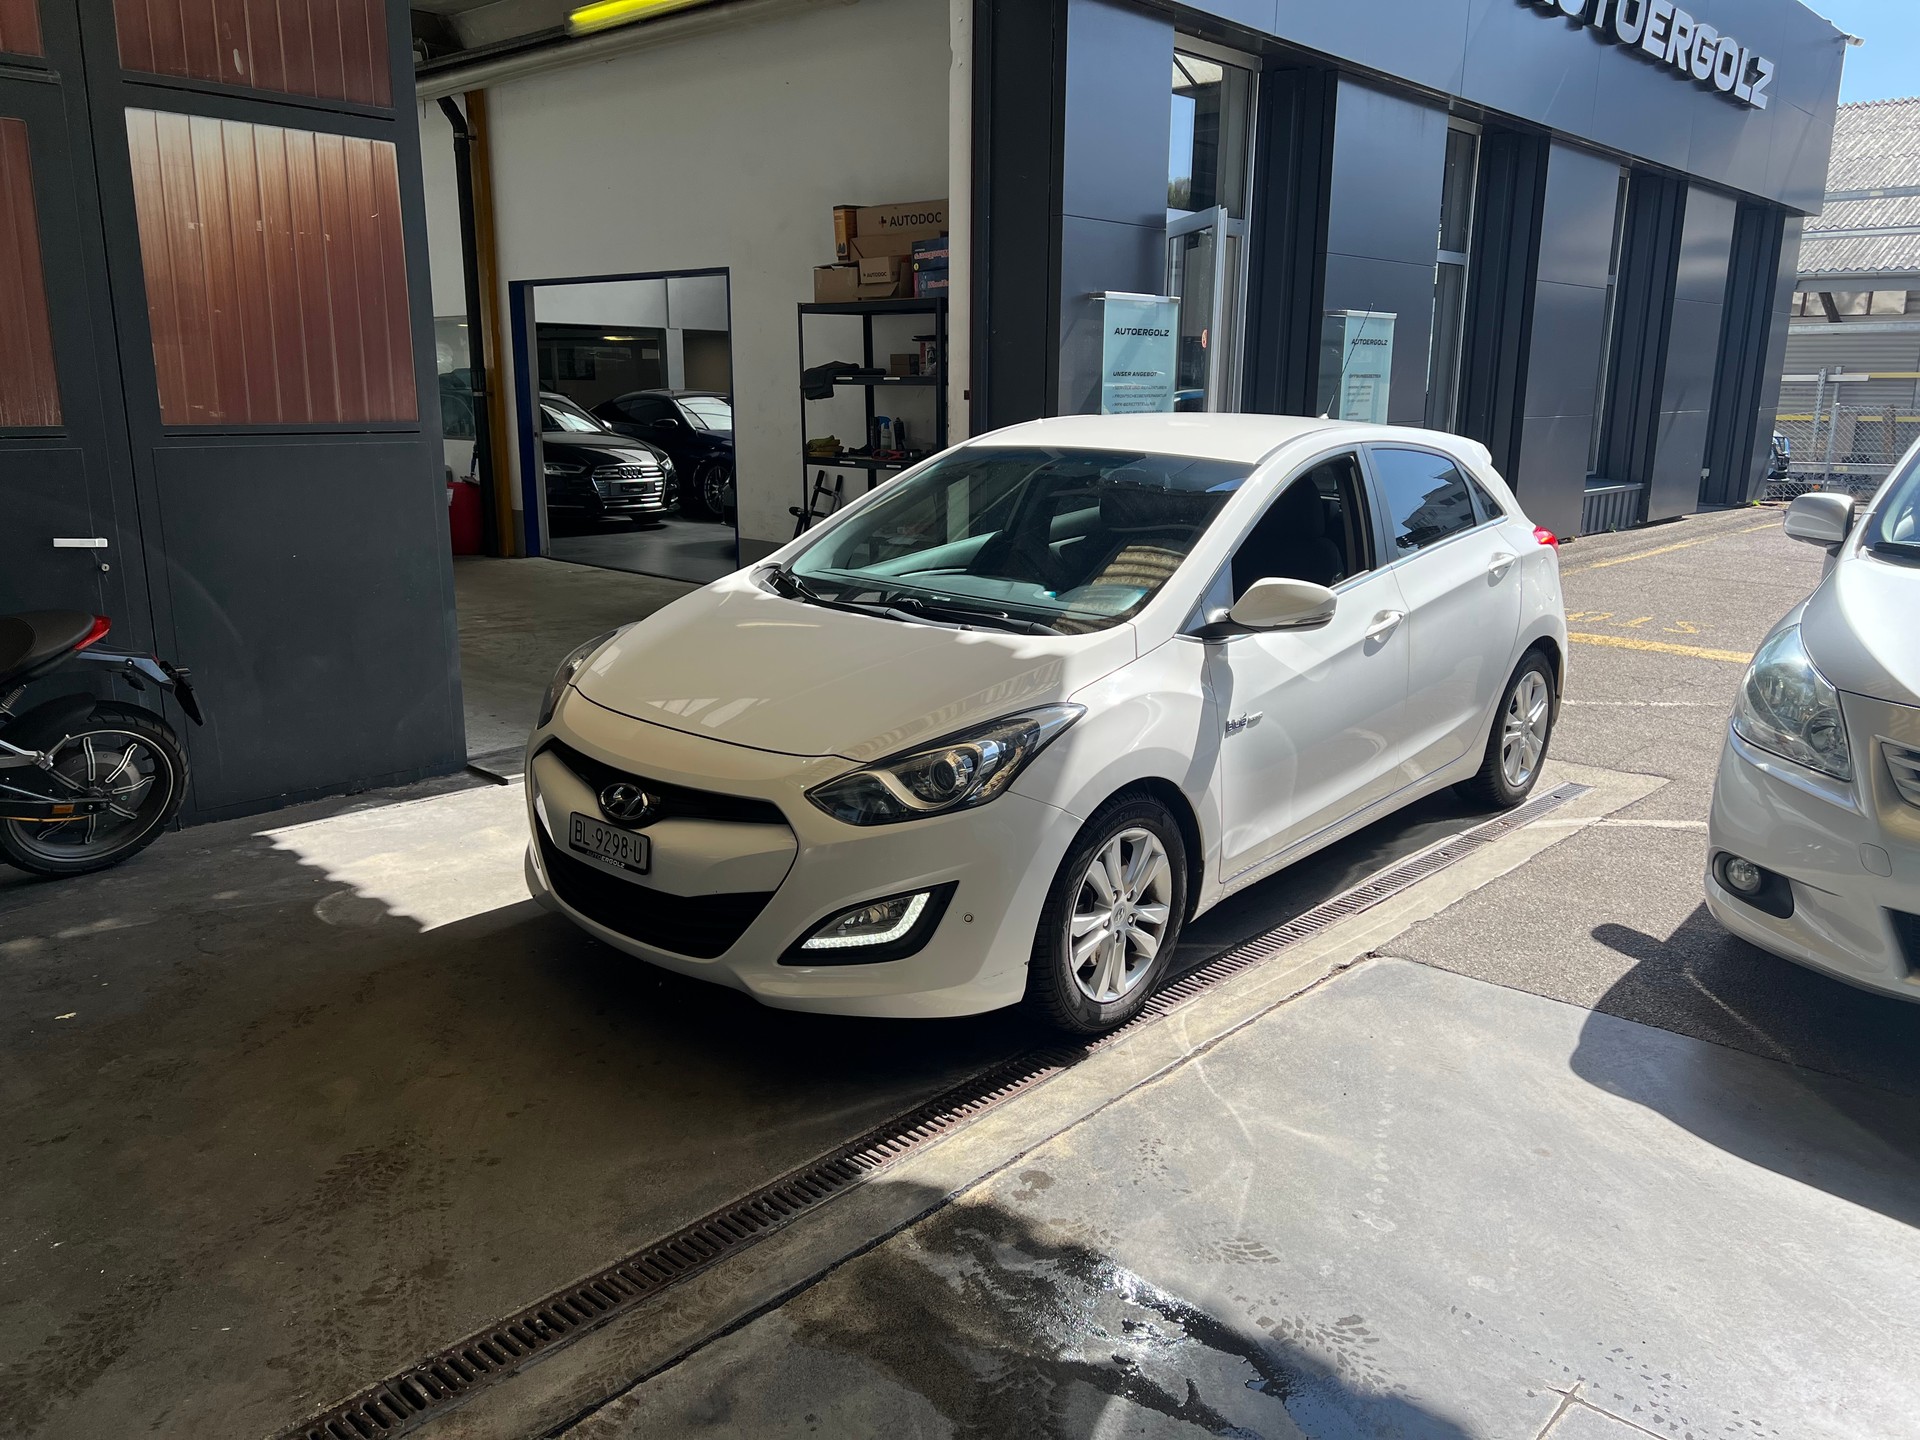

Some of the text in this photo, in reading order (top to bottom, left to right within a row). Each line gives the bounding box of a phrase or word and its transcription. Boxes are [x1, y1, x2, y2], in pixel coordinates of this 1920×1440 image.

[1544, 0, 1774, 110] OERGOLZ
[890, 212, 942, 227] AUTODOC
[1114, 327, 1170, 337] AUTOERGOLZ
[1351, 338, 1389, 346] AUTOERGOLZ
[586, 849, 626, 870] AUTOERGOLZ
